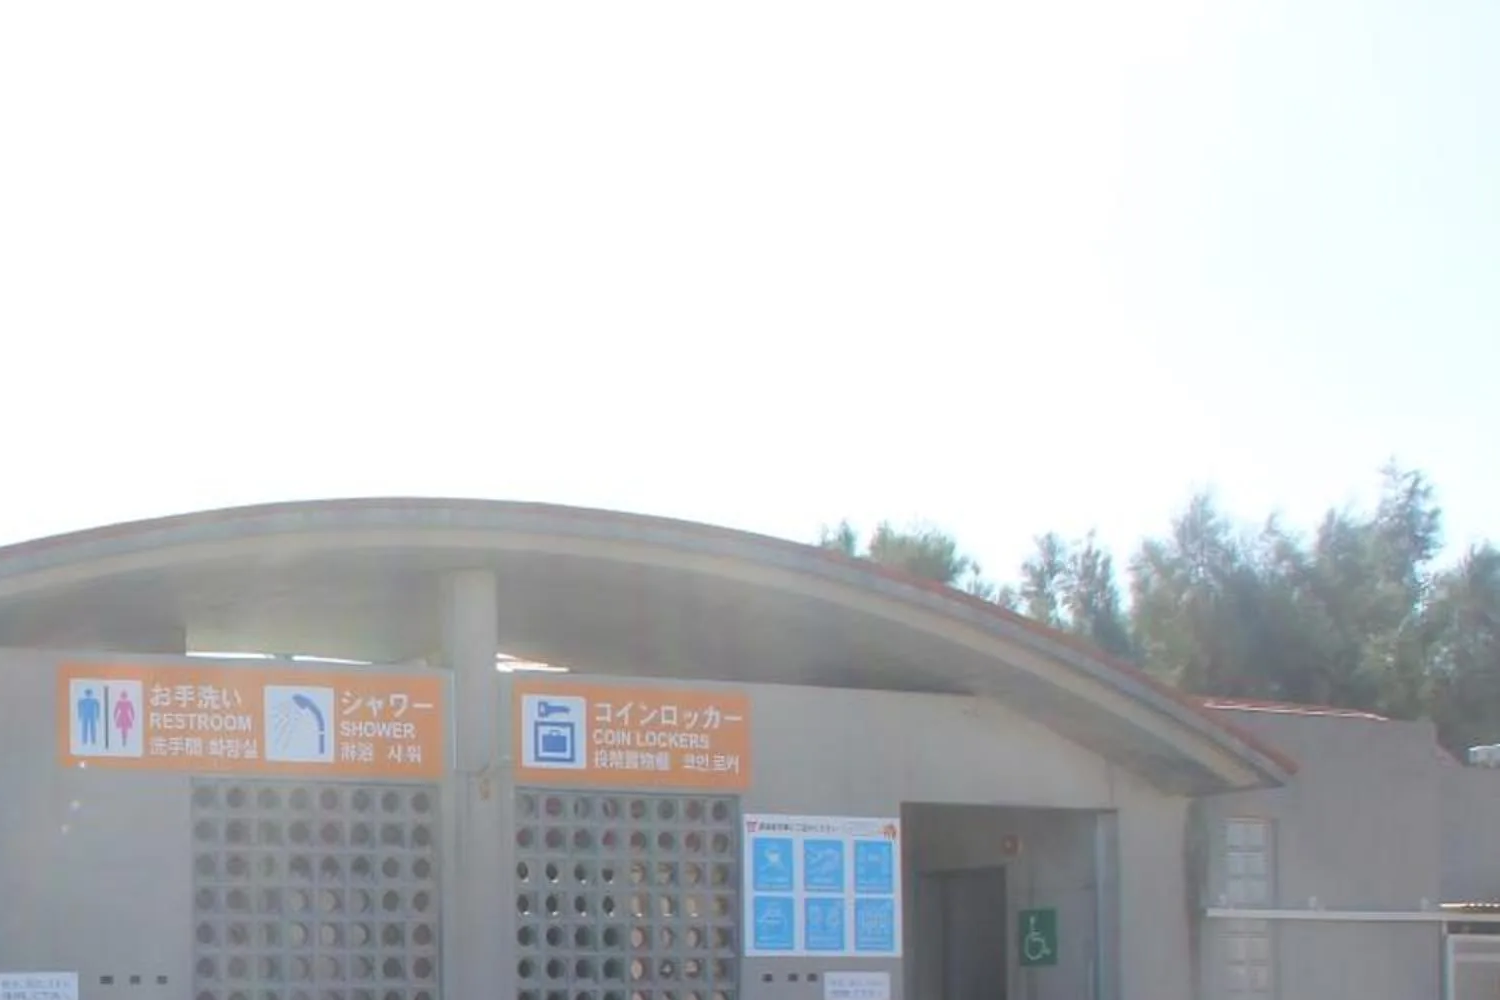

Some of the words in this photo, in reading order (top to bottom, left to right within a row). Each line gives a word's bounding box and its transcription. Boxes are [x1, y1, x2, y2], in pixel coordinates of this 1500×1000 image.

[150, 684, 241, 709] お手洗い
[341, 691, 434, 717] シャワー
[149, 711, 253, 733] RESTROOM
[595, 702, 742, 729] コインロッカー
[339, 719, 417, 740] SHOWER
[592, 728, 631, 746] COIN
[635, 731, 710, 750] LOCKERS
